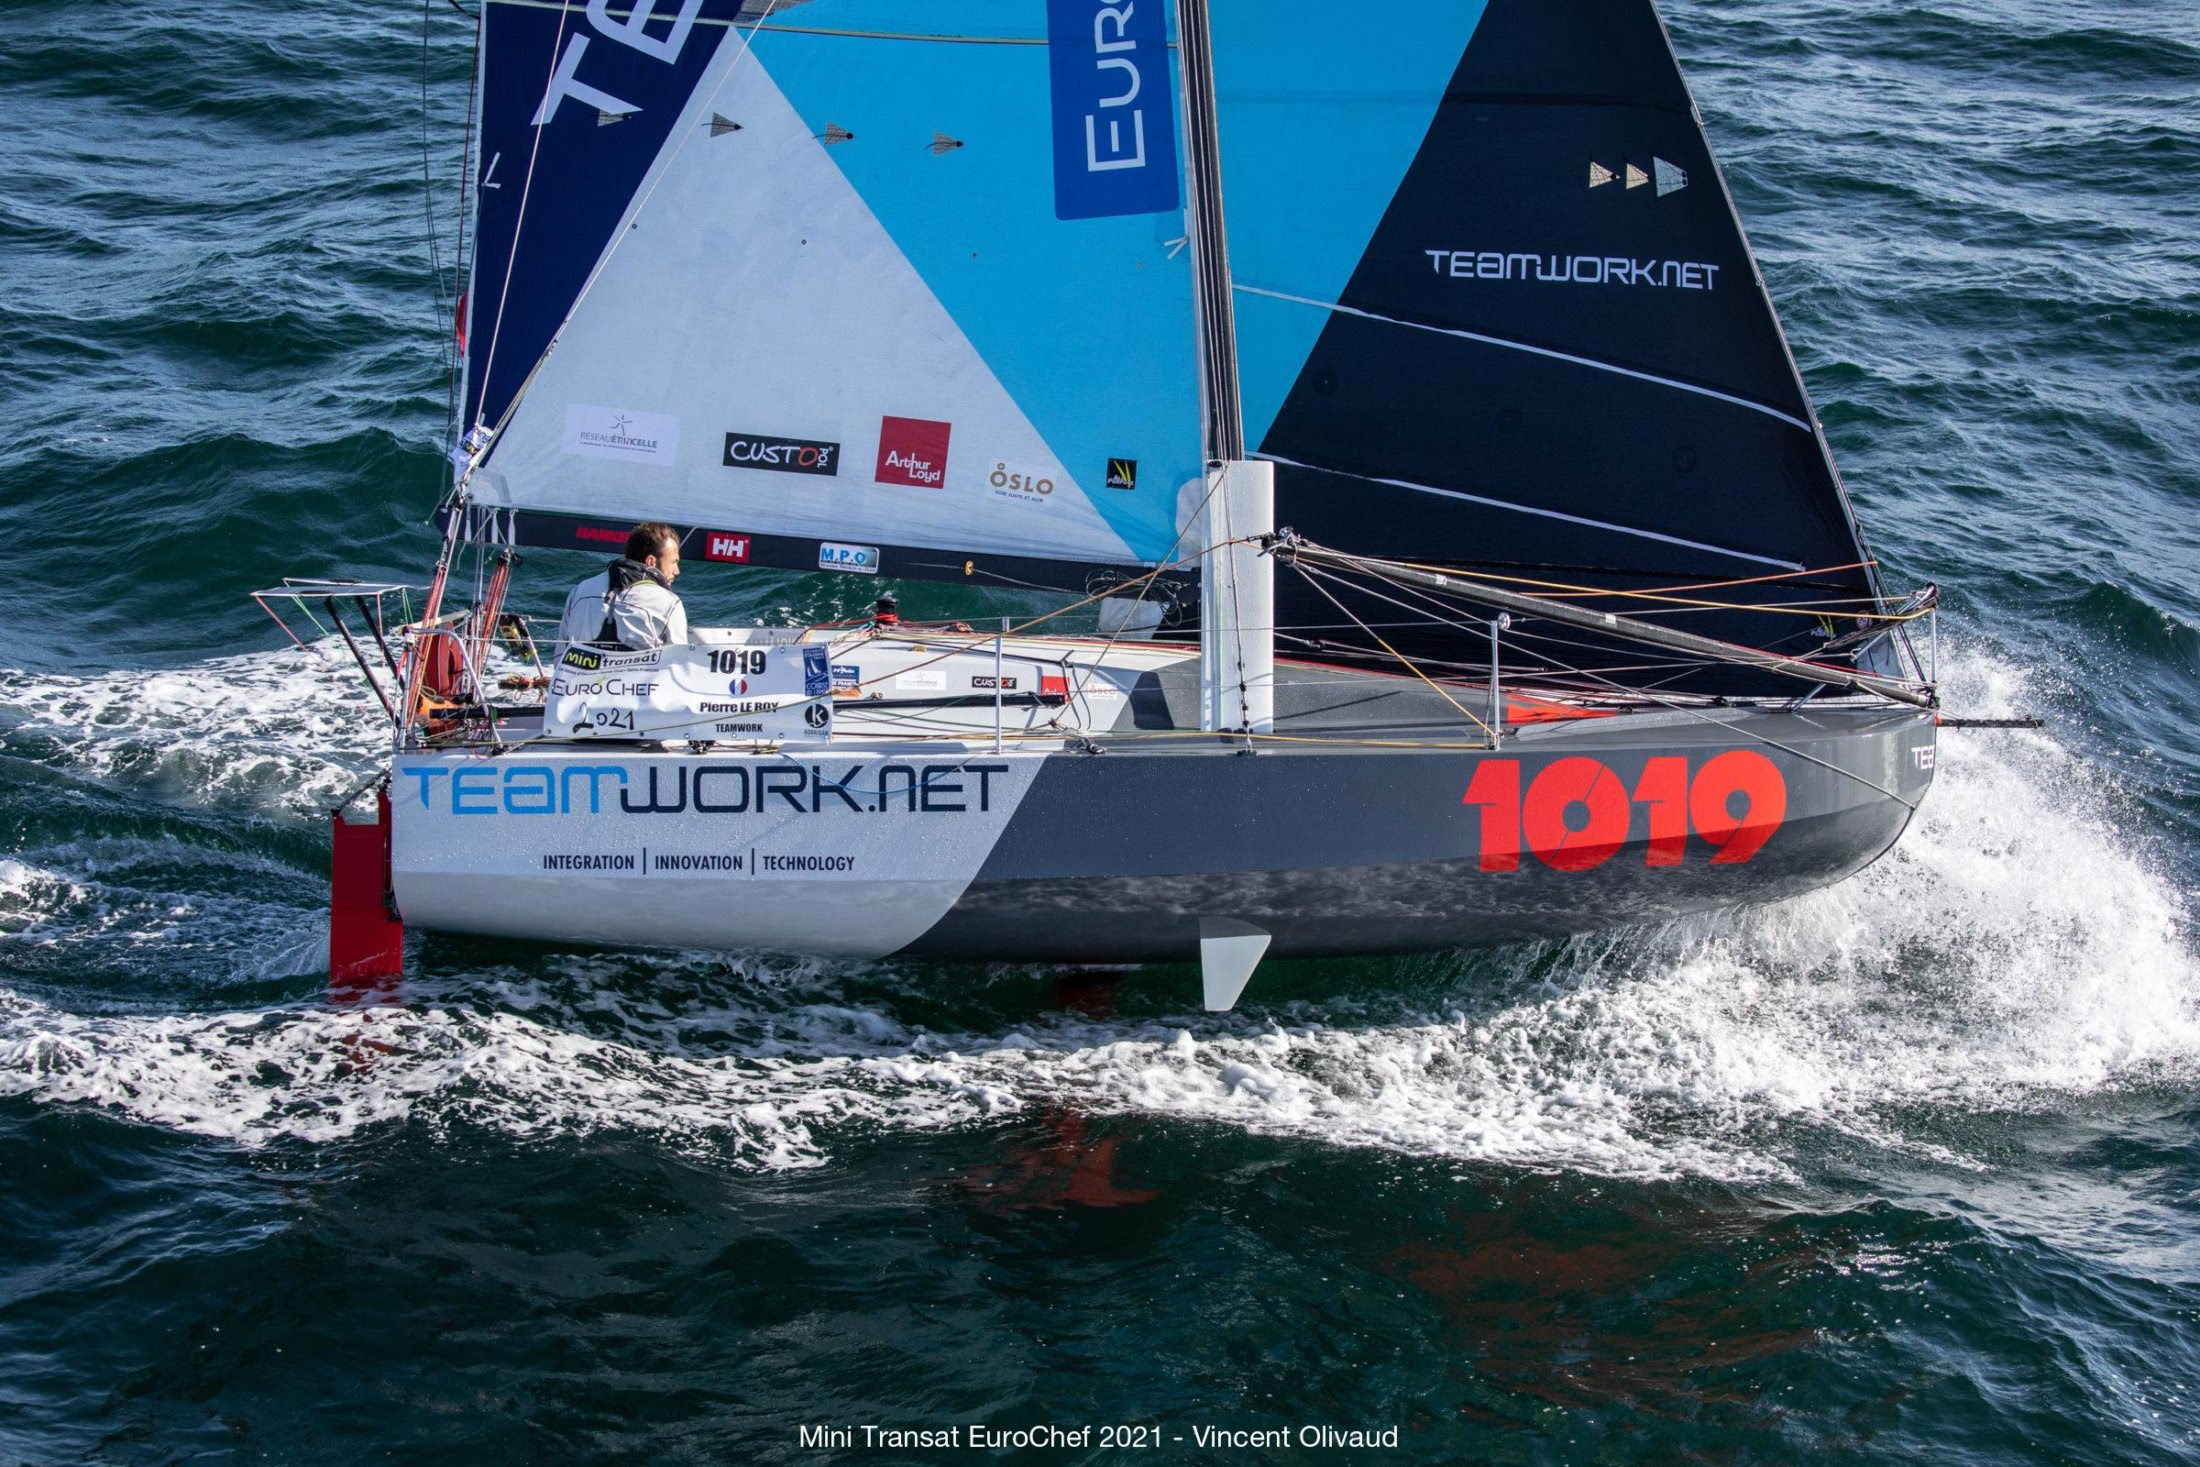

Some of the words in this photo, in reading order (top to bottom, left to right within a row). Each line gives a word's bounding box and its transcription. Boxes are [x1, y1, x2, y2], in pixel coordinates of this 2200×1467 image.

[1085, 0, 1146, 172] EUR
[1425, 249, 1720, 291] TEAMWORK.NET
[730, 441, 819, 467] CUSTO
[885, 450, 931, 470] Arthur
[909, 469, 941, 483] Loyd
[602, 652, 658, 667] transat
[707, 650, 767, 675] 1019
[572, 702, 634, 734] 2021
[700, 702, 738, 713] Pierre
[740, 702, 752, 713] LE
[754, 702, 780, 713] ROY
[715, 723, 763, 733] TEAMWORK
[402, 765, 1009, 815] TEAMWORK.NET
[1462, 750, 1788, 873] 1019
[543, 854, 635, 870] INTEGRATION
[655, 855, 743, 870] INNOVATION
[762, 855, 855, 871] TECHNOLOGY
